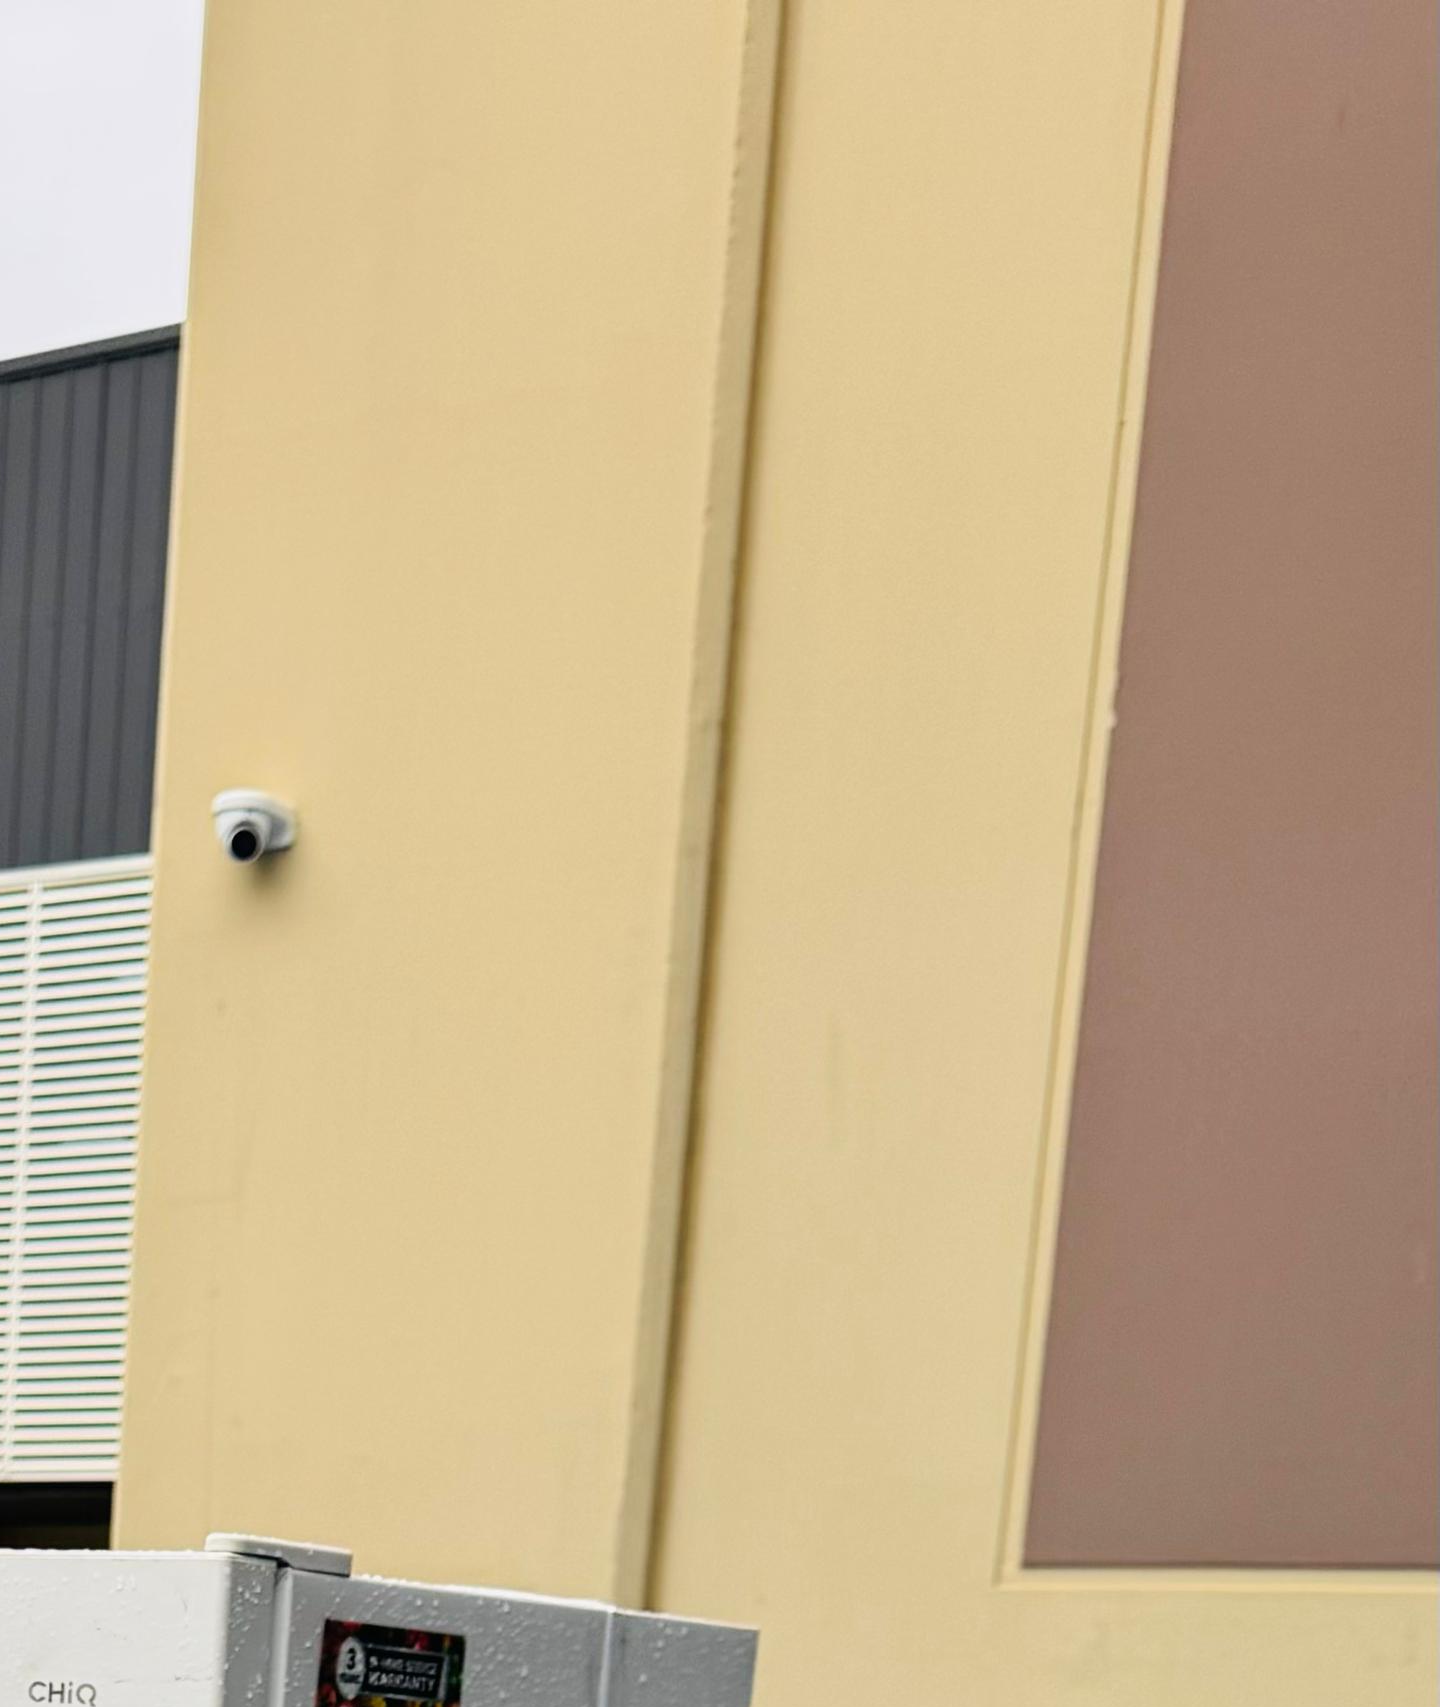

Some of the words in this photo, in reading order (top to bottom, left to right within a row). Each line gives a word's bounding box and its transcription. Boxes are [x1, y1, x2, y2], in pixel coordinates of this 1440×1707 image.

[344, 1647, 357, 1670] 3
[367, 1671, 436, 1692] WARRANTY
[28, 1680, 97, 1707] CHiQ
